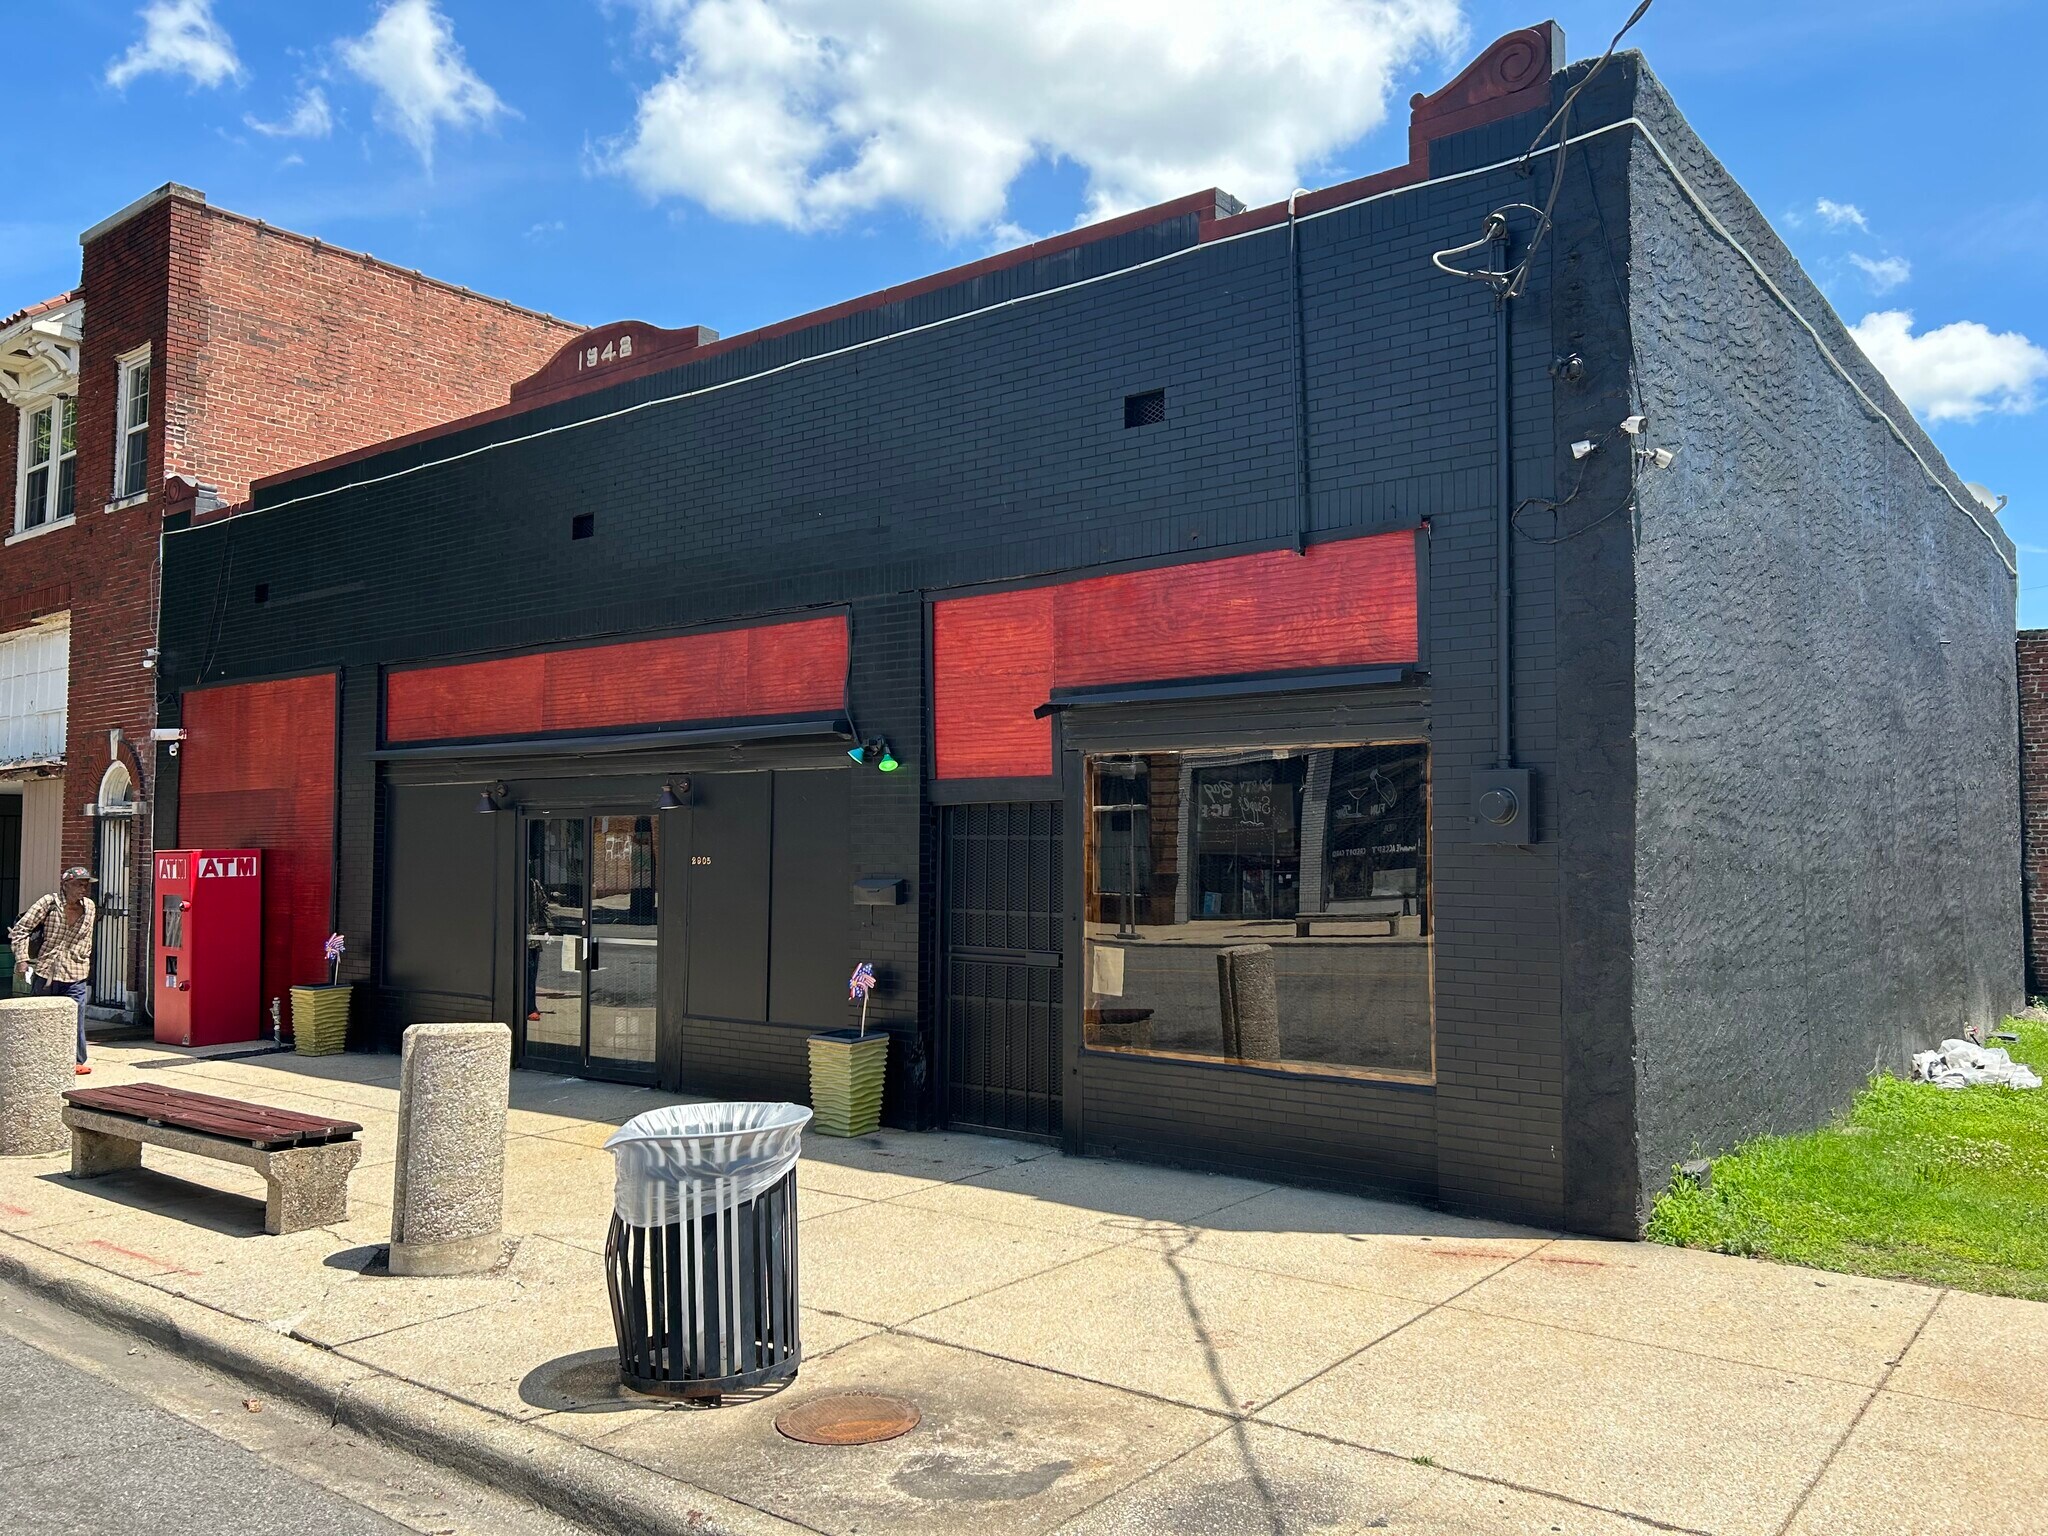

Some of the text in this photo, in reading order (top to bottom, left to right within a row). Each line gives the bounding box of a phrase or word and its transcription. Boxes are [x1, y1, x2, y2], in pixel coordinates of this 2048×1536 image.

[578, 335, 632, 371] 1948
[160, 859, 187, 879] ATM
[201, 857, 255, 877] ATM
